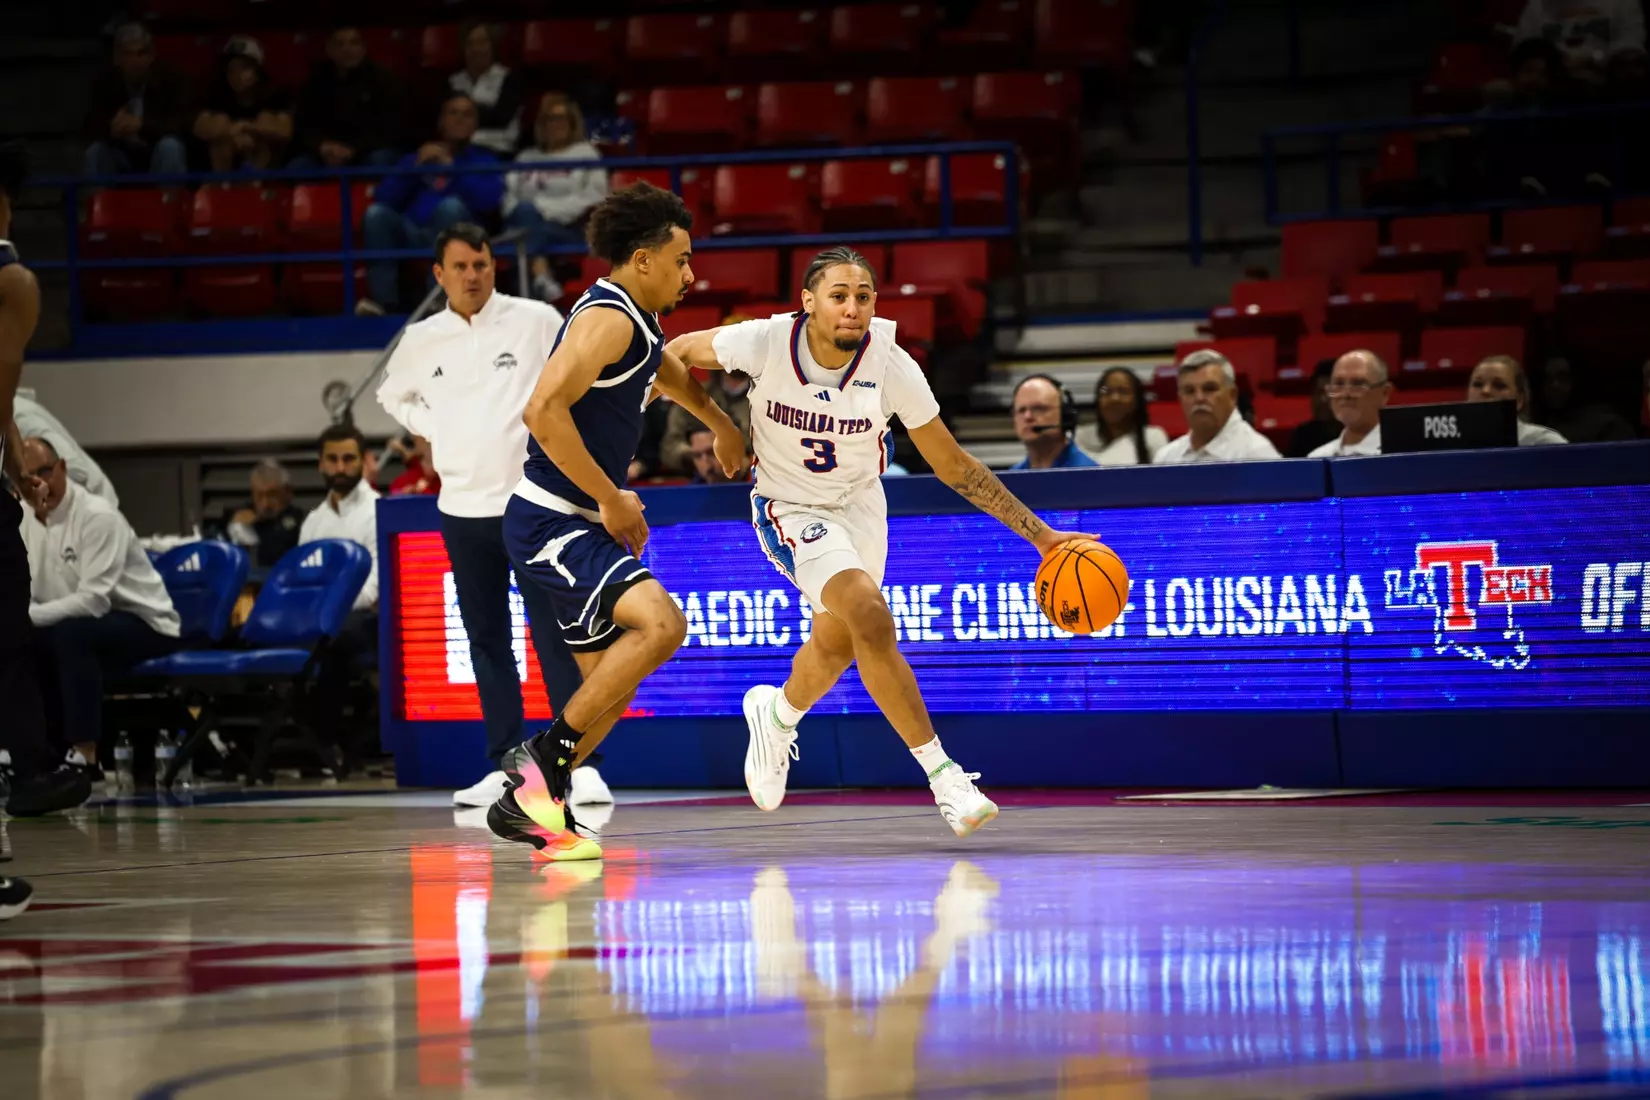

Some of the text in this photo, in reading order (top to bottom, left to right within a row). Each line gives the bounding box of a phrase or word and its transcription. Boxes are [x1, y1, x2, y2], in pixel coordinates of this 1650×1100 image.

[766, 400, 834, 433] LOUISIANA
[1424, 415, 1461, 439] POSS.
[800, 437, 838, 473] 3
[669, 588, 791, 647] AEDIC
[1145, 574, 1374, 637] LOUISIANA
